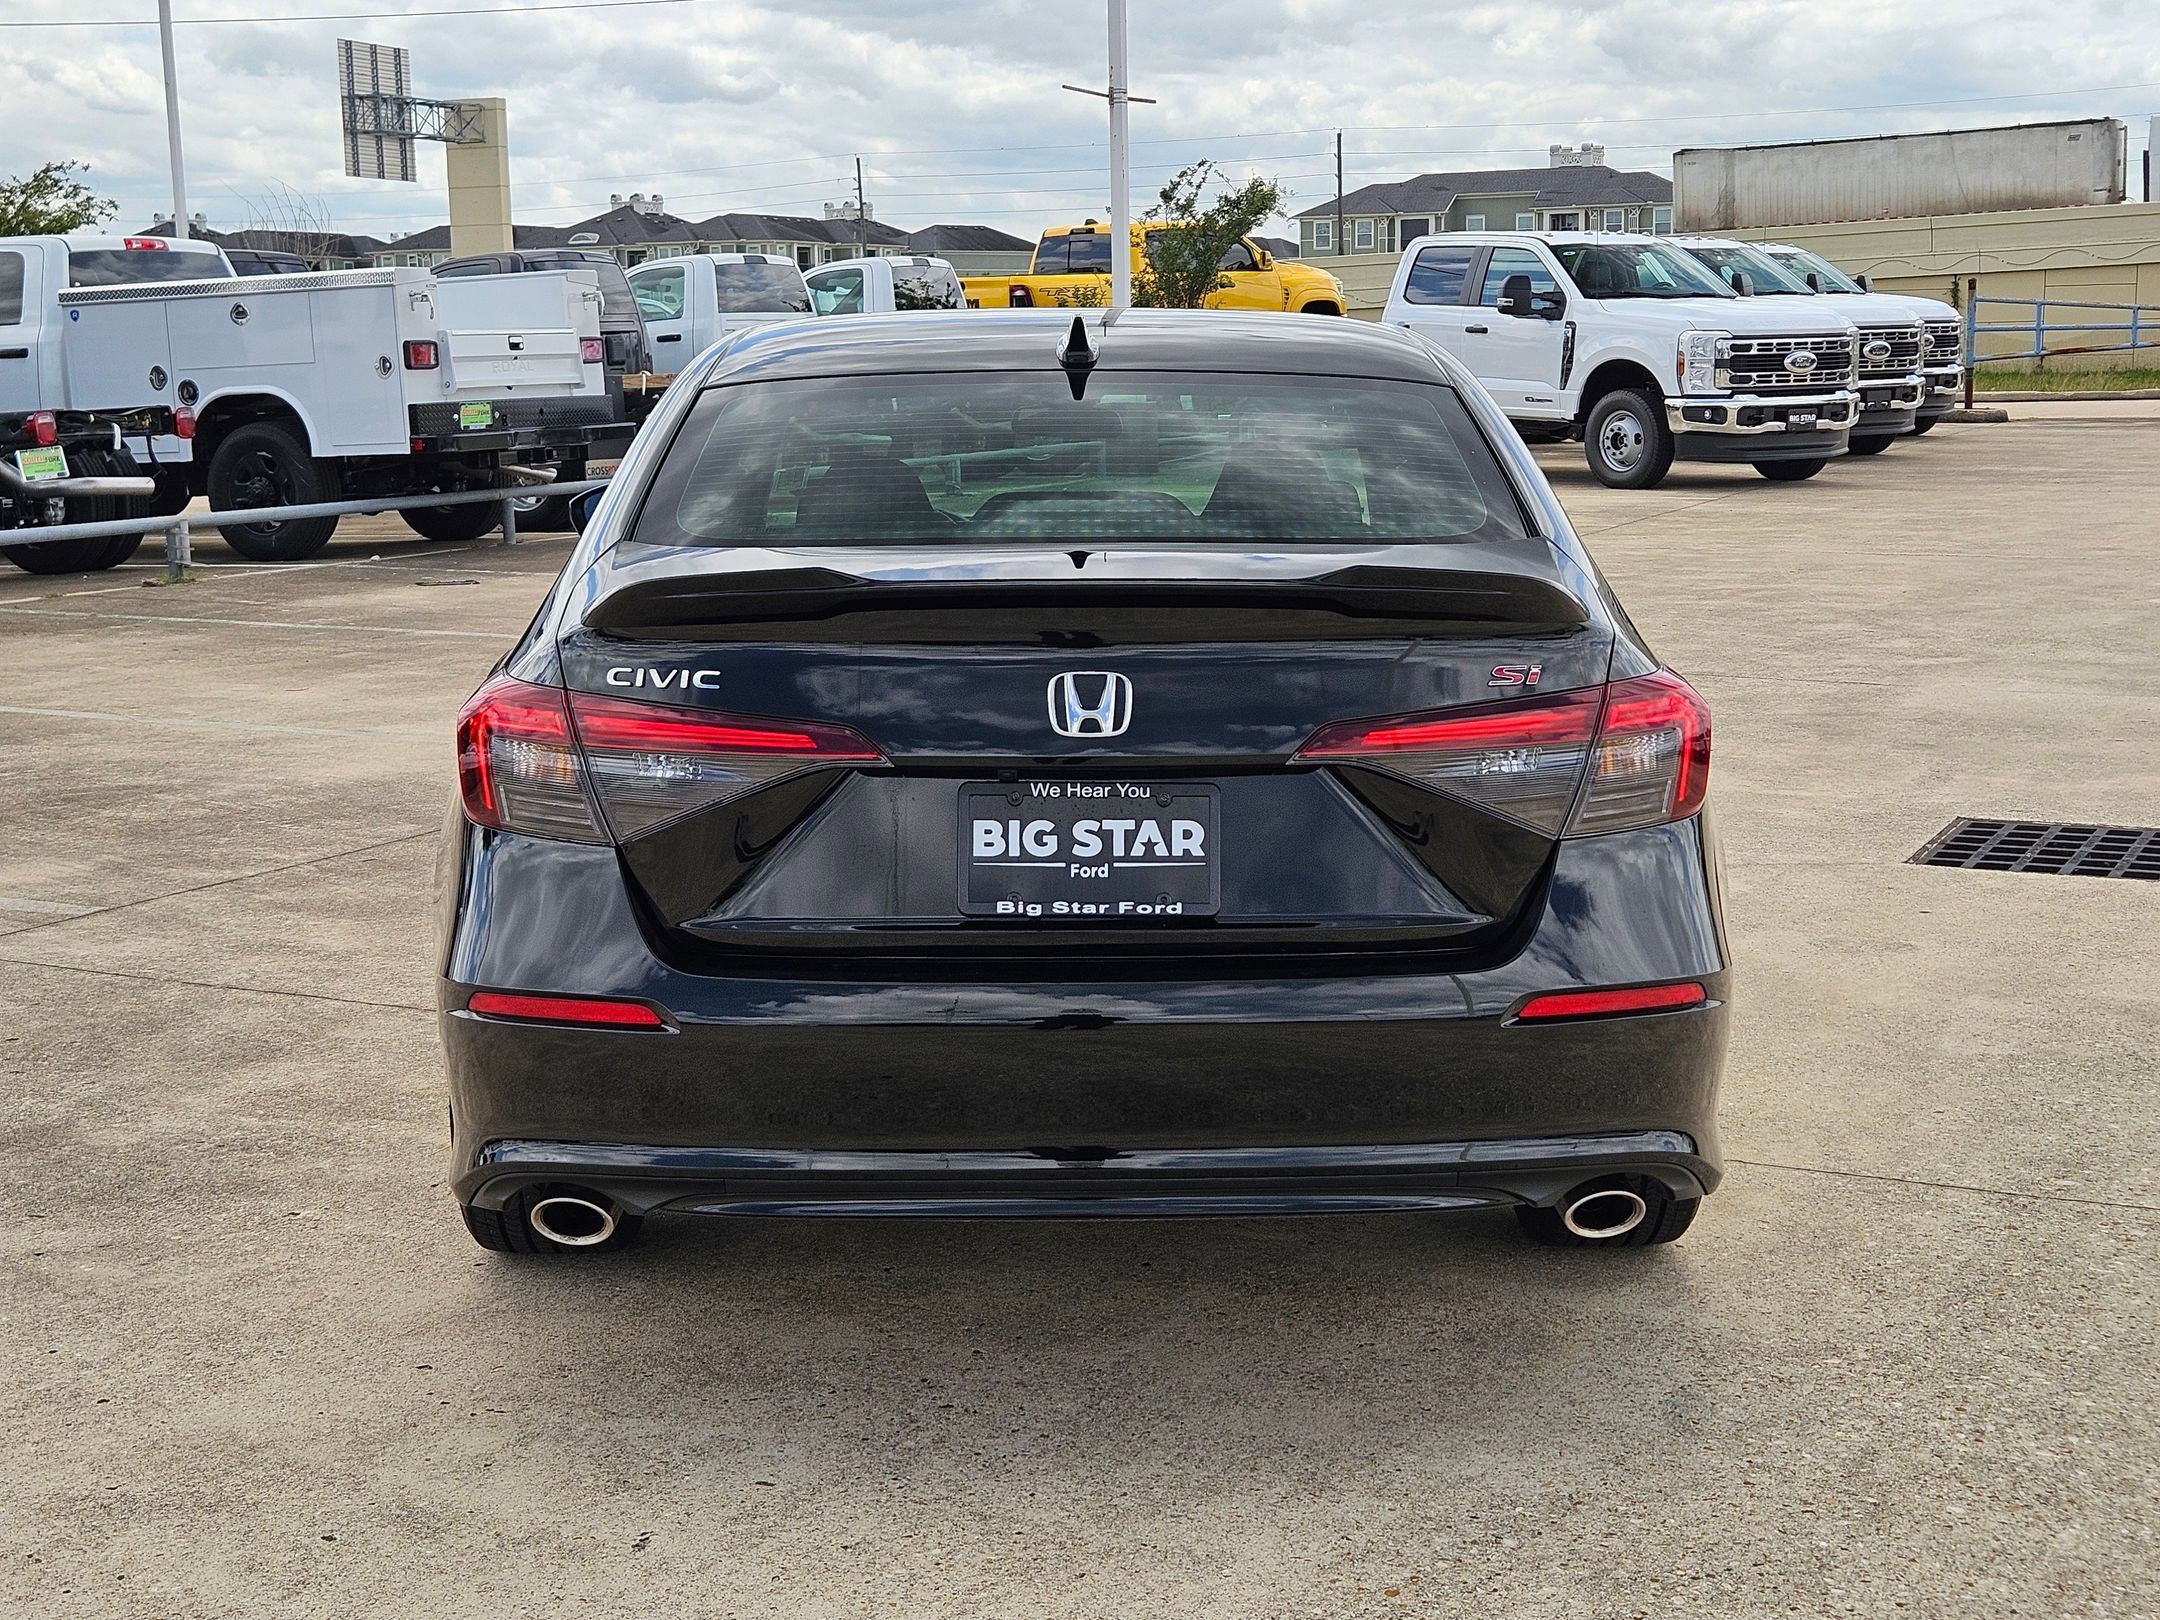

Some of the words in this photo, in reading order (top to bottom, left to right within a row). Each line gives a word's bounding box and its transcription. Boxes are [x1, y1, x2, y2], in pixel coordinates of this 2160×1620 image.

[1789, 414, 1800, 422] BIG
[1800, 413, 1817, 421] STAR
[606, 667, 721, 689] CIVIC
[1488, 664, 1542, 686] Si
[1030, 782, 1062, 798] We
[1066, 782, 1111, 798] Hear
[1115, 782, 1151, 799] You
[972, 819, 1058, 858] BIG
[1071, 819, 1206, 858] STAR
[1069, 862, 1109, 879] Ford
[996, 900, 1042, 916] Big
[1051, 900, 1110, 915] Star
[1117, 900, 1183, 915] Ford
